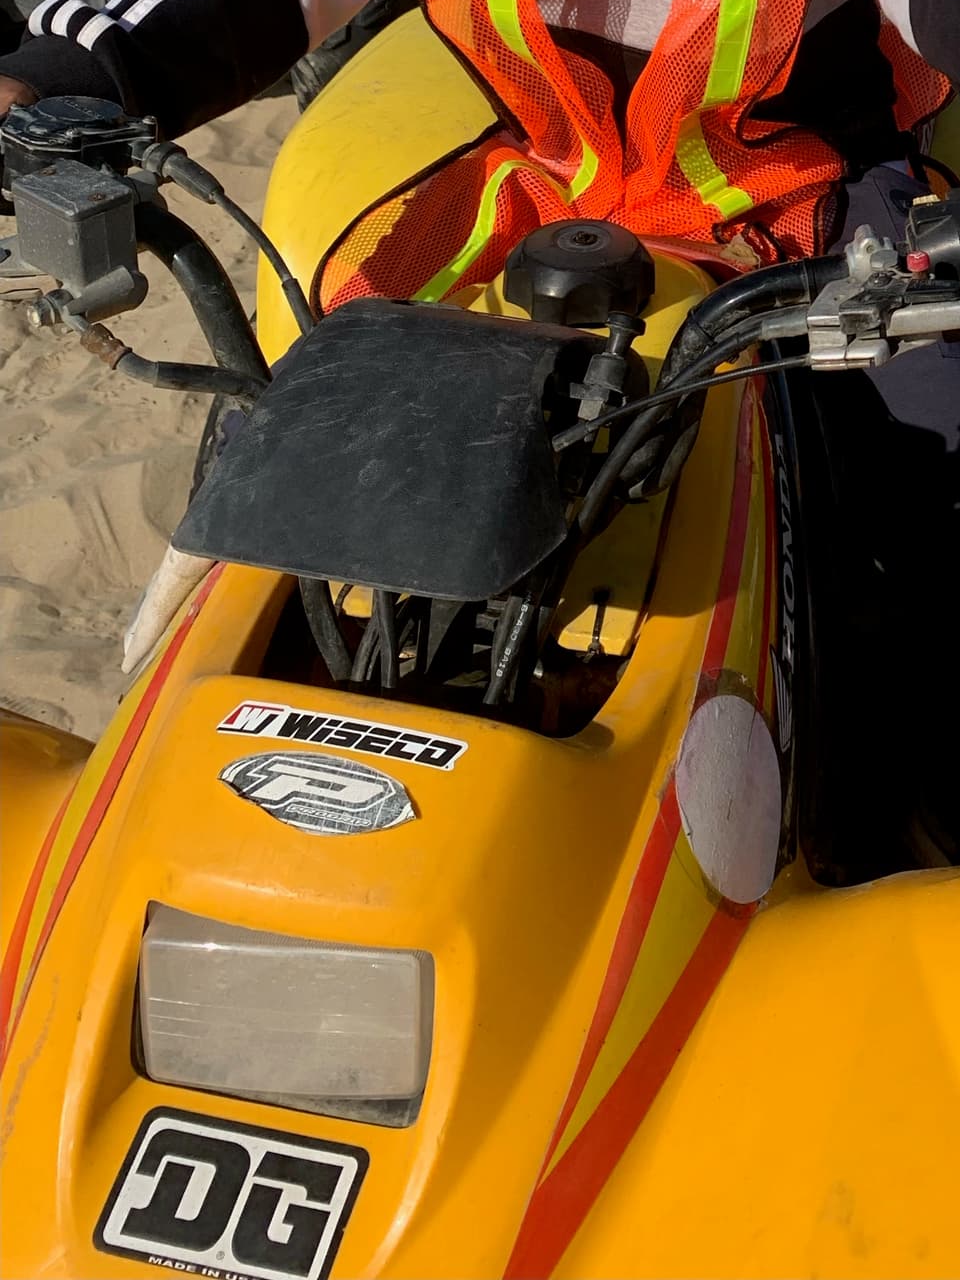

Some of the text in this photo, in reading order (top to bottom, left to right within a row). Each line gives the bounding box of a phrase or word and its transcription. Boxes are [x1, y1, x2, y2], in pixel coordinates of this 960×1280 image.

[773, 432, 796, 675] HONDA
[119, 1128, 342, 1277] DG
[147, 1256, 197, 1273] MADE
[201, 1268, 220, 1279] IN
